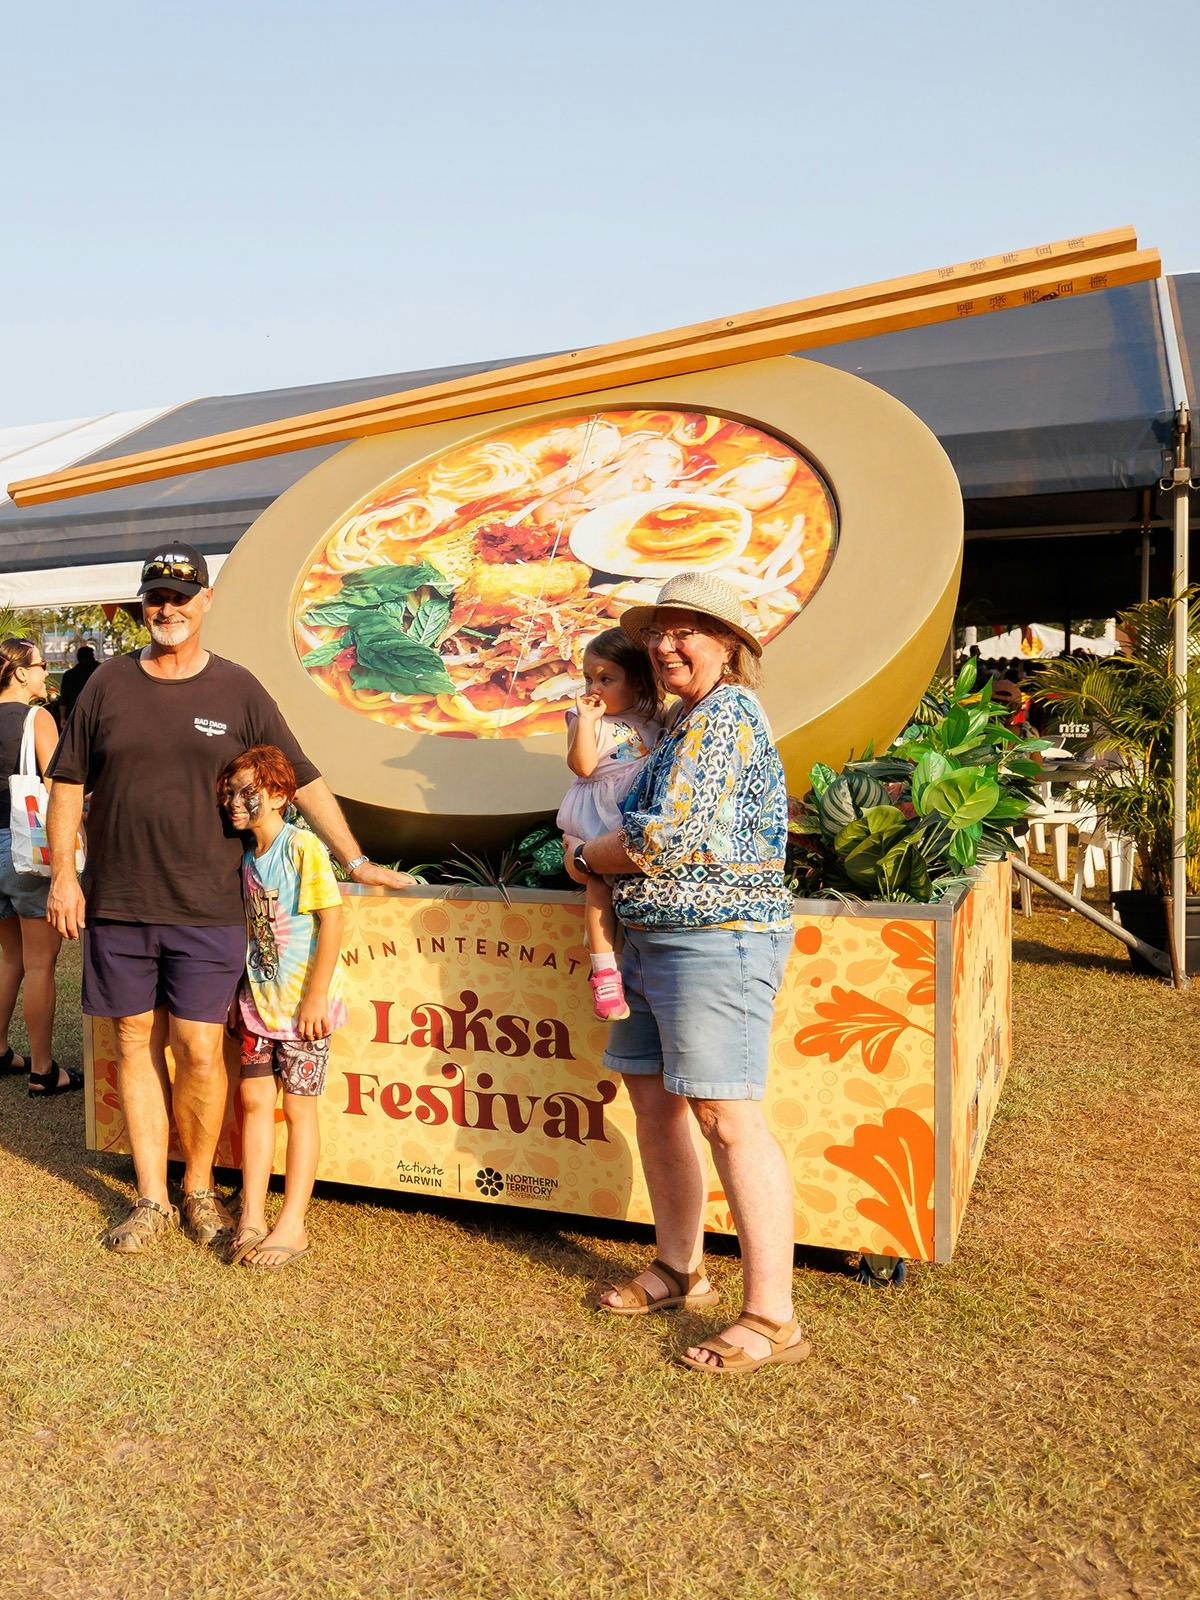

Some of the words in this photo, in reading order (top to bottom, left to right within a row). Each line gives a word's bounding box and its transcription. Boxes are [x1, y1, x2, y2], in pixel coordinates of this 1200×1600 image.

[194, 717, 208, 726] BAD
[341, 940, 397, 967] WIN
[416, 937, 593, 981] INTERNAT
[369, 990, 576, 1061] Laksa
[341, 1062, 618, 1146] Festival
[396, 1160, 445, 1176] Activate
[399, 1174, 442, 1188] DARWIN
[505, 1174, 558, 1188] NORTHERN
[505, 1182, 552, 1196] TERRITORY
[505, 1190, 551, 1201] GOVERNMENT
